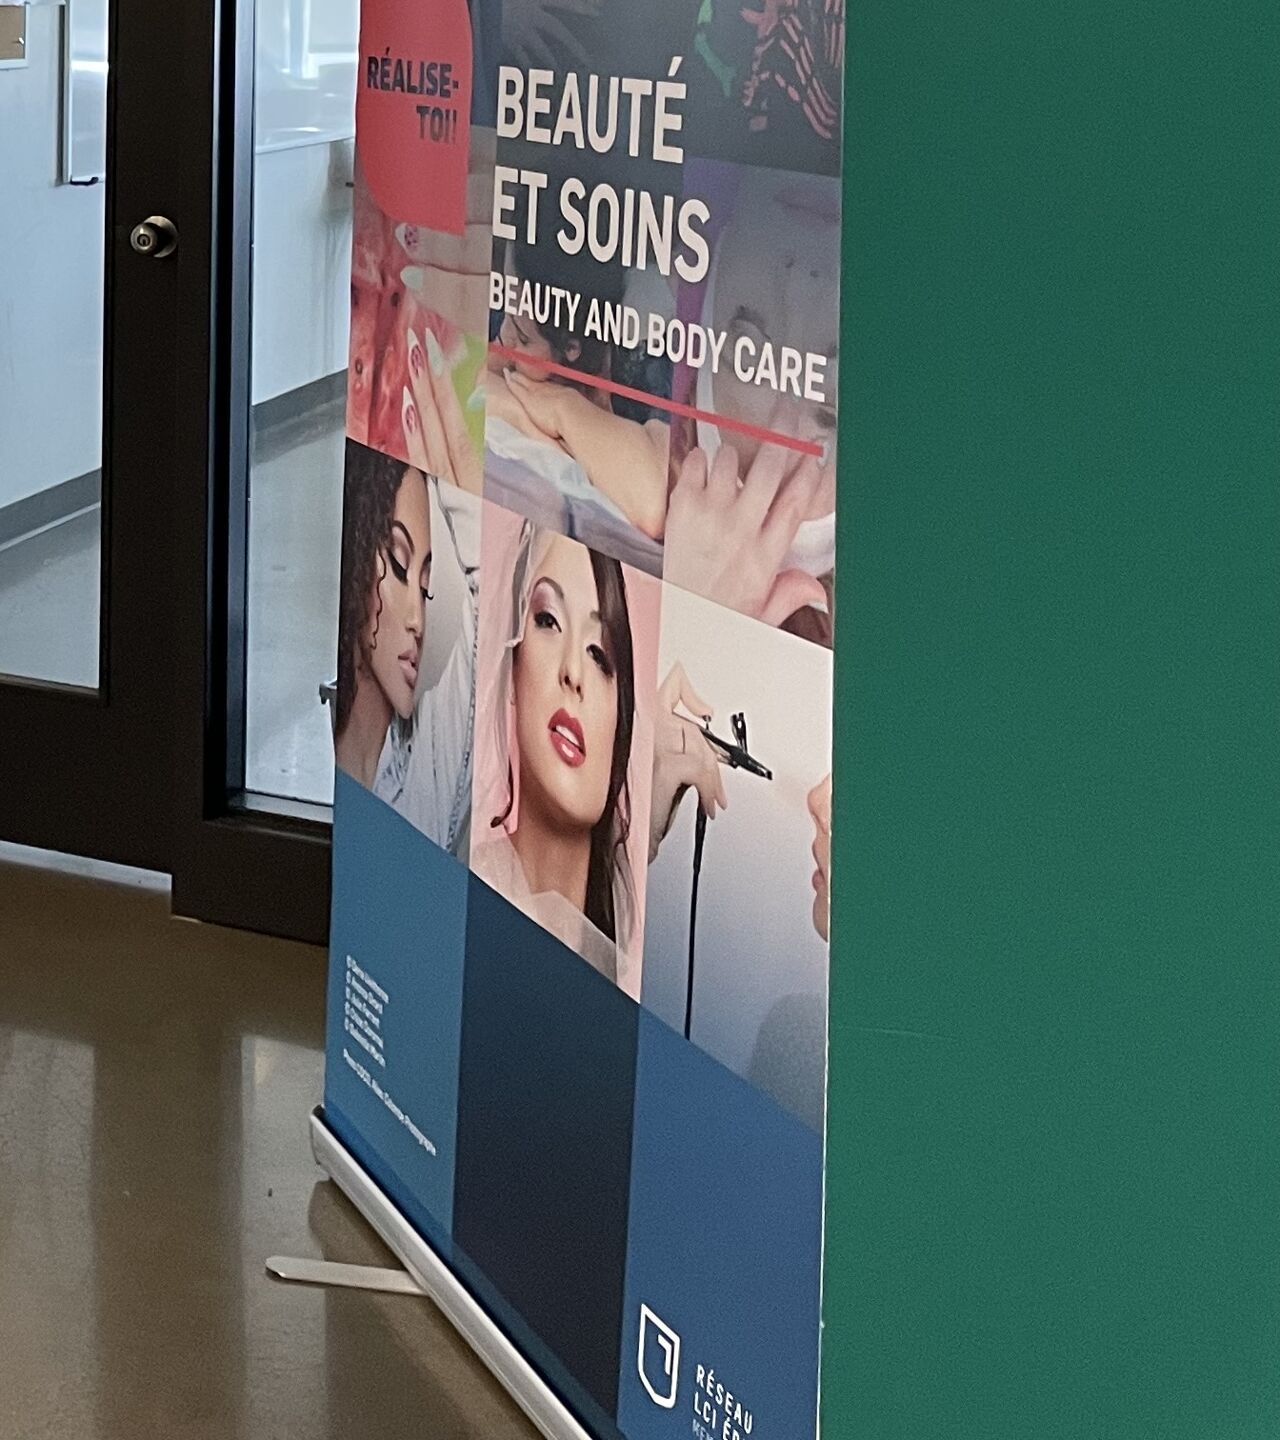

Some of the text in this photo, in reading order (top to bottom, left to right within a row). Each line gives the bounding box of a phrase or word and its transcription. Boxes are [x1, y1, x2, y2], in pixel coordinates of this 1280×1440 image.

[366, 46, 459, 98] RÉALISE-
[496, 55, 688, 165] BEAUTÉ
[492, 165, 711, 283] ET SOINS
[489, 271, 827, 403] BEAUTY AND BODY CARE
[694, 1391, 717, 1429] LCI
[696, 1364, 753, 1434] RÉSEAU
